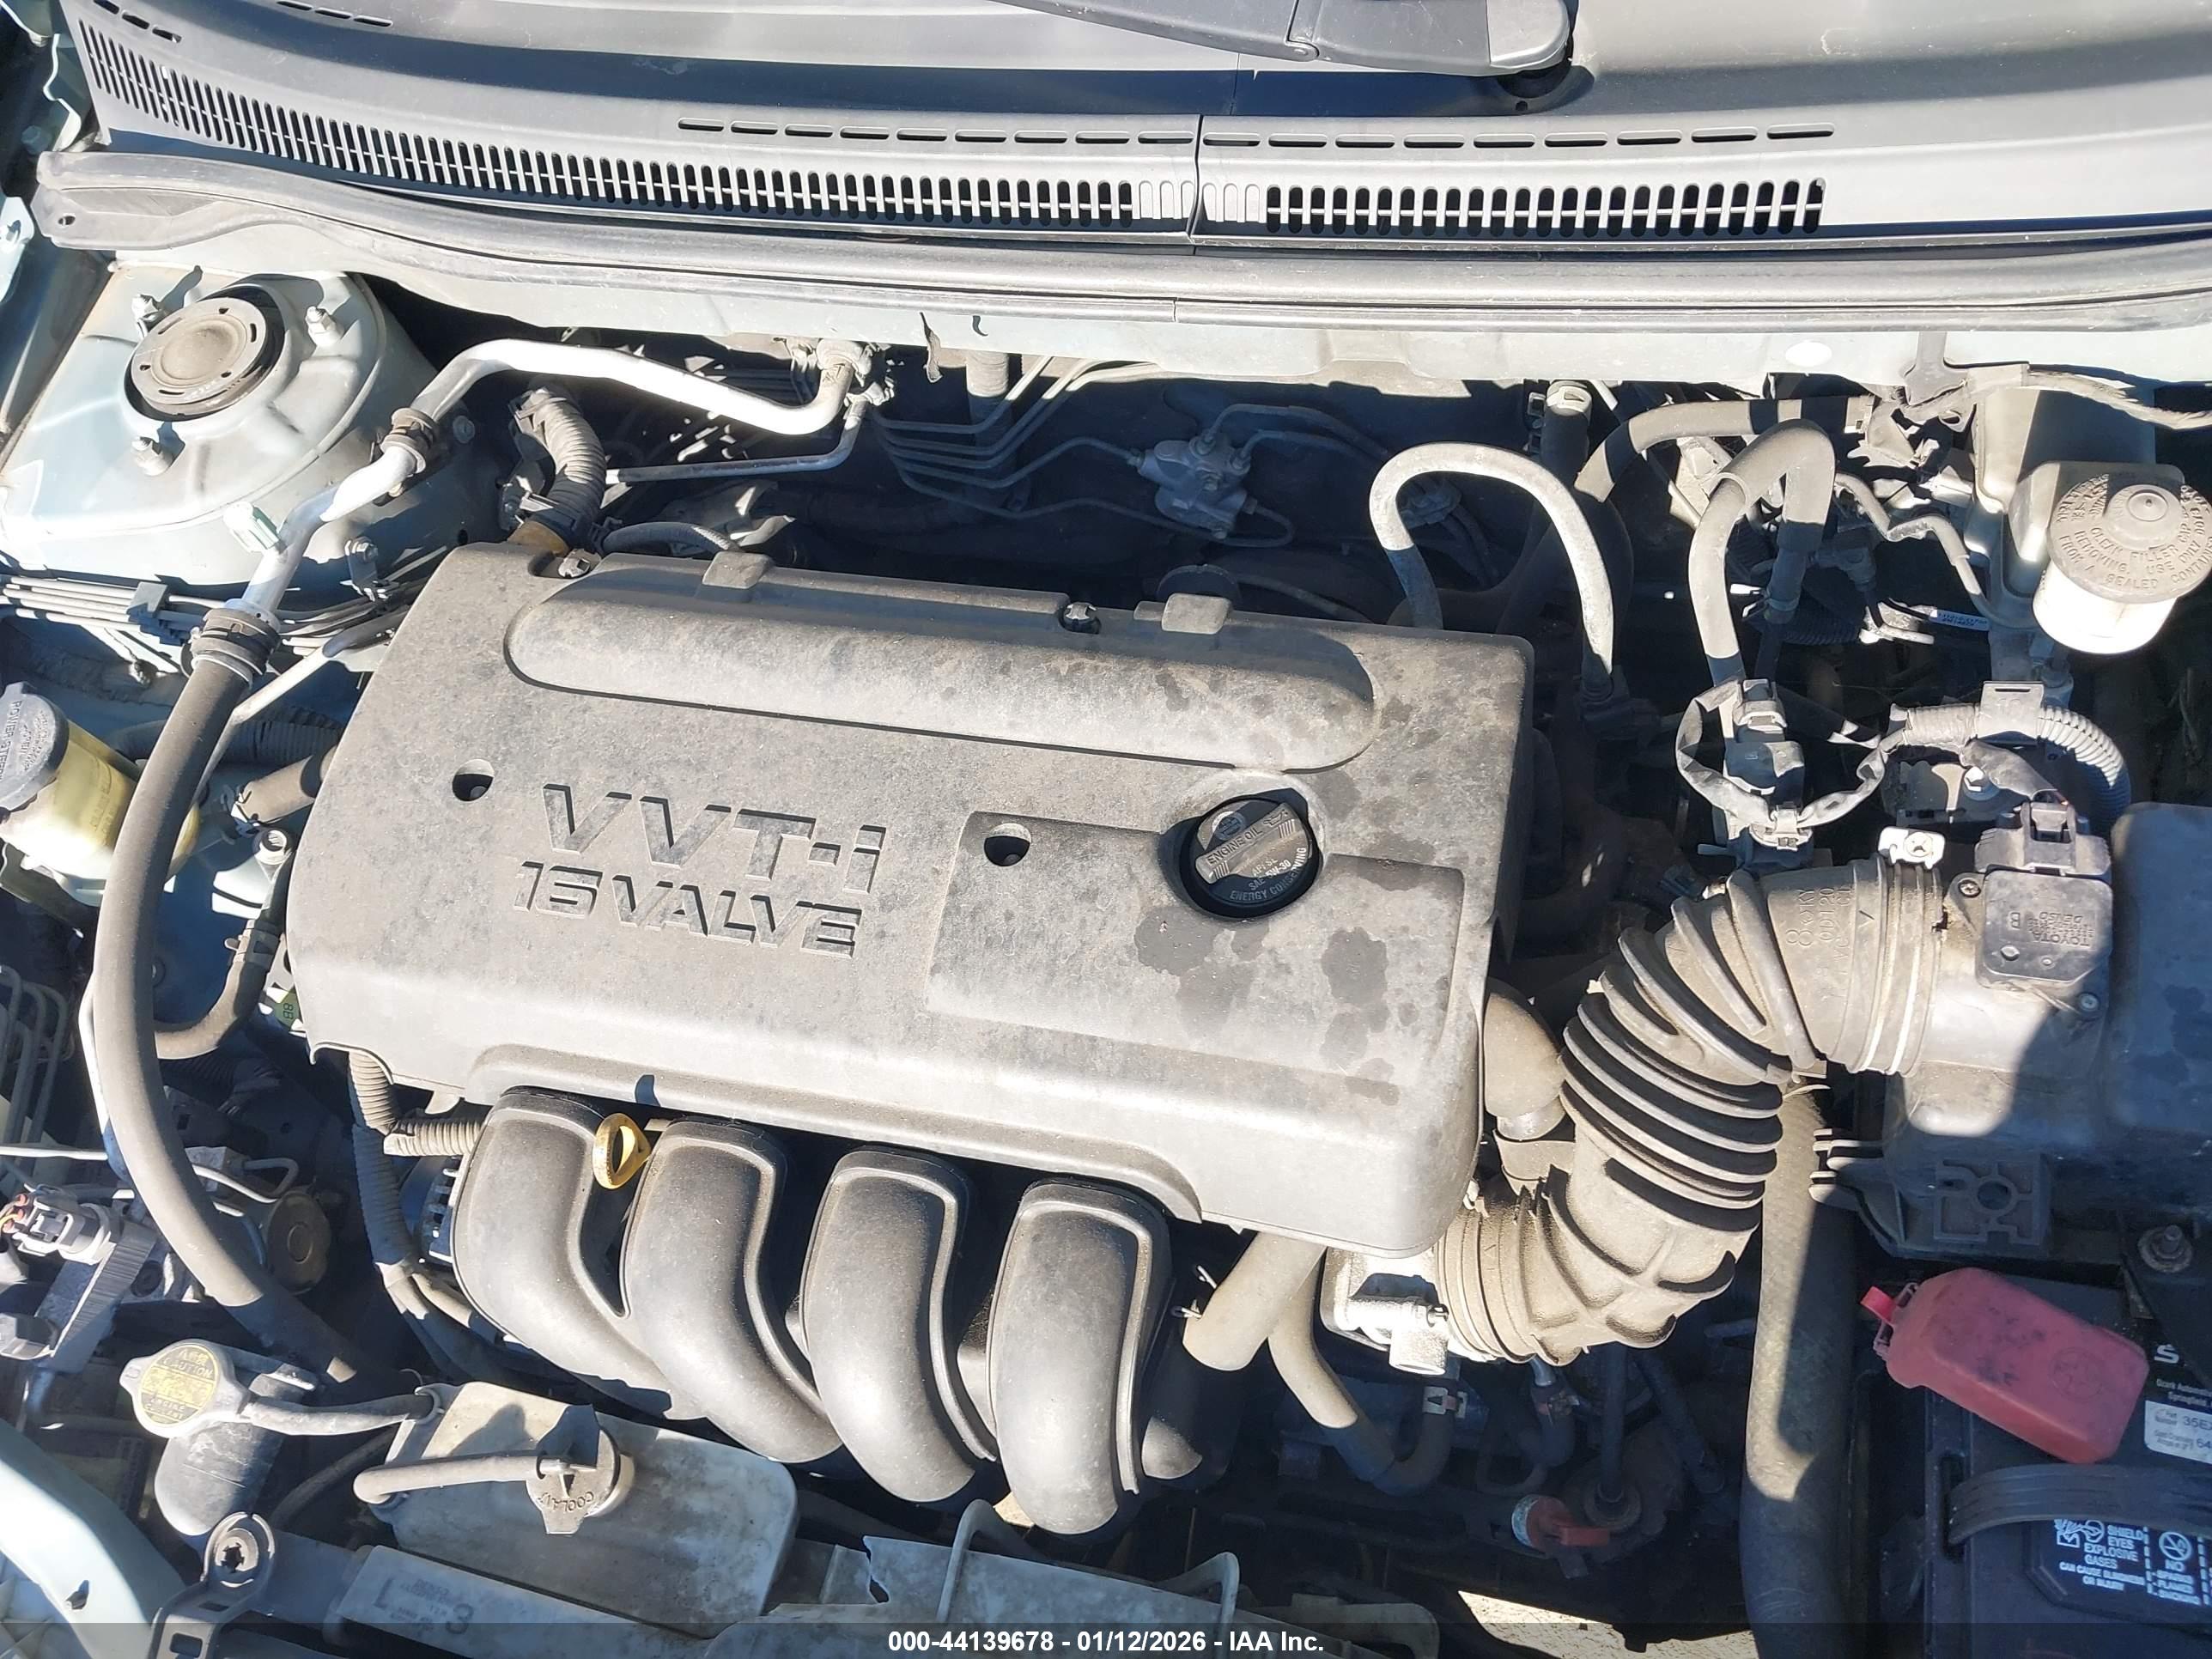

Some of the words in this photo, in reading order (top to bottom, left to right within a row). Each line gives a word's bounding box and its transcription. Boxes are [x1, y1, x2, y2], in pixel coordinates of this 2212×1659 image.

[2146, 560, 2175, 574] USE
[2105, 573, 2159, 590] SEALED
[6, 700, 22, 738] POWER
[542, 782, 888, 895] VVT-i
[1206, 836, 1246, 866] ENGINE
[1244, 826, 1264, 842] OIL
[1229, 888, 1268, 902] ENERGY
[1269, 847, 1308, 896] CONSERVING
[1248, 878, 1267, 891] SAE
[1264, 859, 1293, 879] 5W-30
[513, 860, 604, 920] 16
[611, 874, 864, 959] VALVE
[2010, 912, 2021, 929] B
[2032, 931, 2090, 947] TOYOTA
[163, 1357, 214, 1376] CAUTION
[2107, 1525, 2143, 1540] SHIELD
[2084, 1542, 2139, 1562] EXPLOSIVE
[2107, 1536, 2135, 1550] EYES
[2084, 1554, 2118, 1570] GASES
[2165, 1559, 2185, 1572] NO
[446, 1603, 474, 1634] 3
